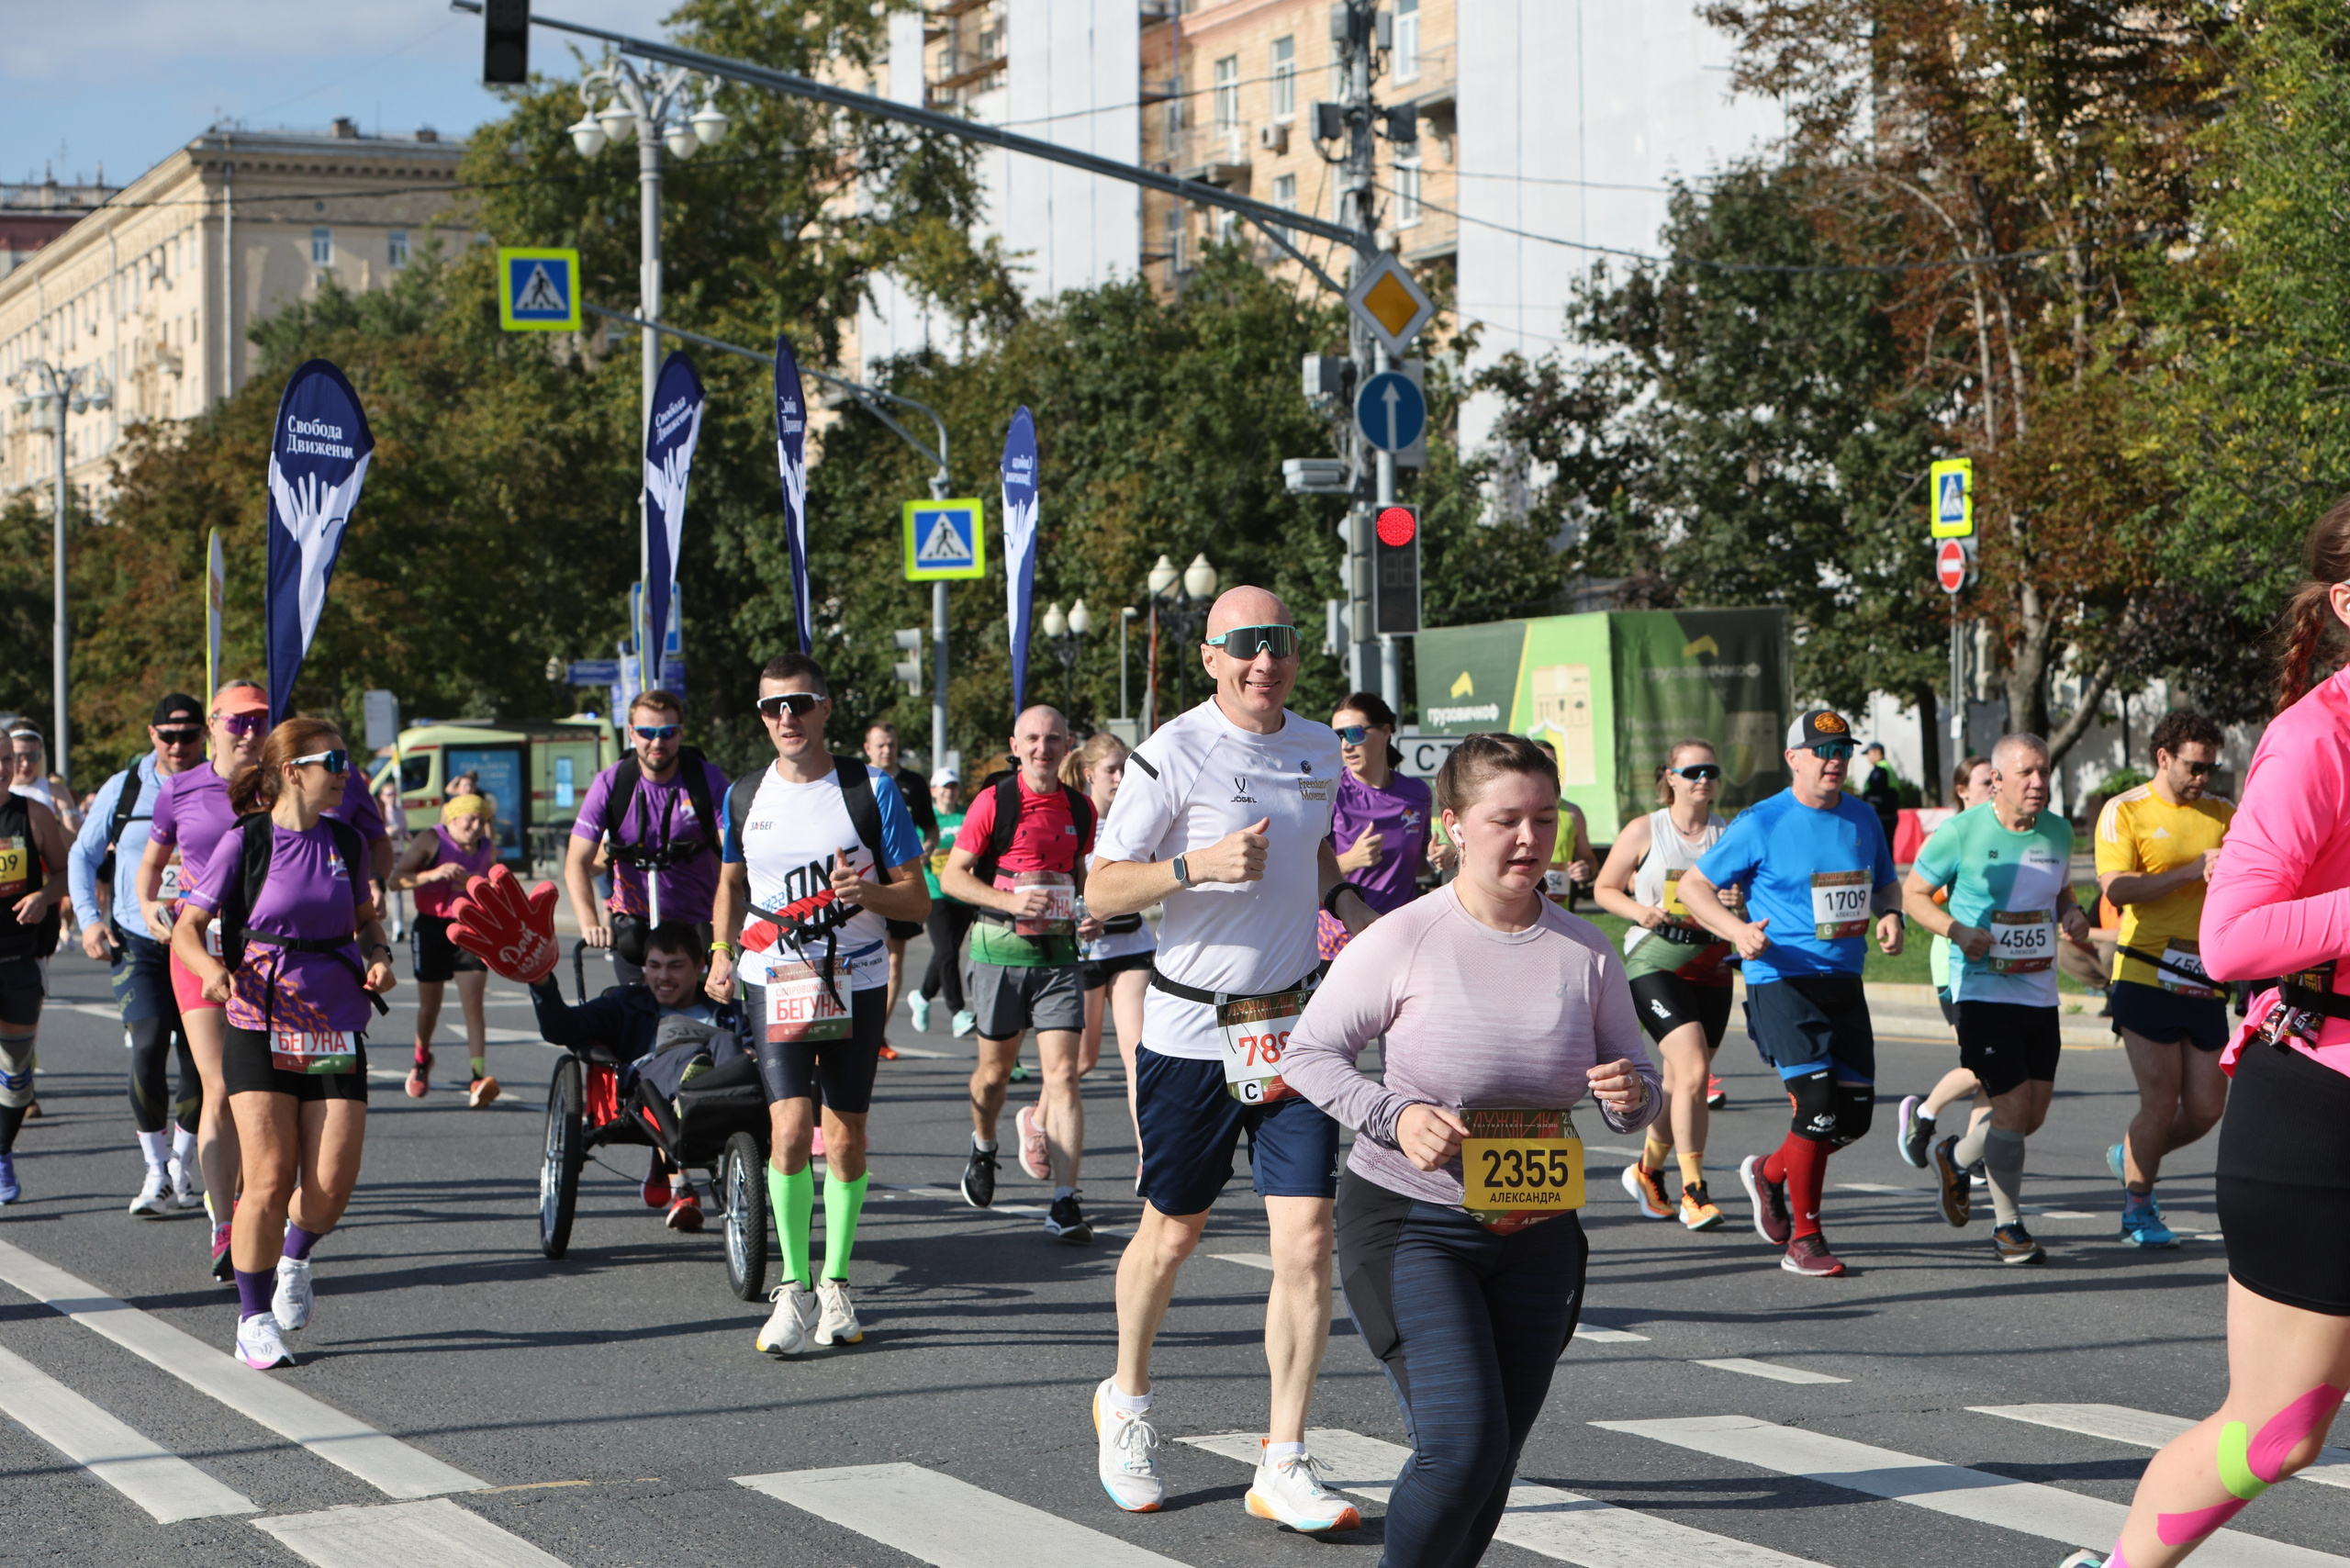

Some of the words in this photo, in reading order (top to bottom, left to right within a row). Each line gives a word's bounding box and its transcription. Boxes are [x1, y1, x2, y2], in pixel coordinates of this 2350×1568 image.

[287, 414, 343, 442] Свобода
[1825, 889, 1867, 911] 1709
[1823, 924, 1833, 935] G
[1999, 927, 2047, 948] 4565
[2009, 947, 2038, 957] АЛЕКСЕЙ
[1996, 959, 2005, 970] D
[776, 993, 845, 1022] БЕГУНА
[1482, 1149, 1569, 1188] 2355
[1489, 1193, 1561, 1204] АЛЕКСАНДРА
